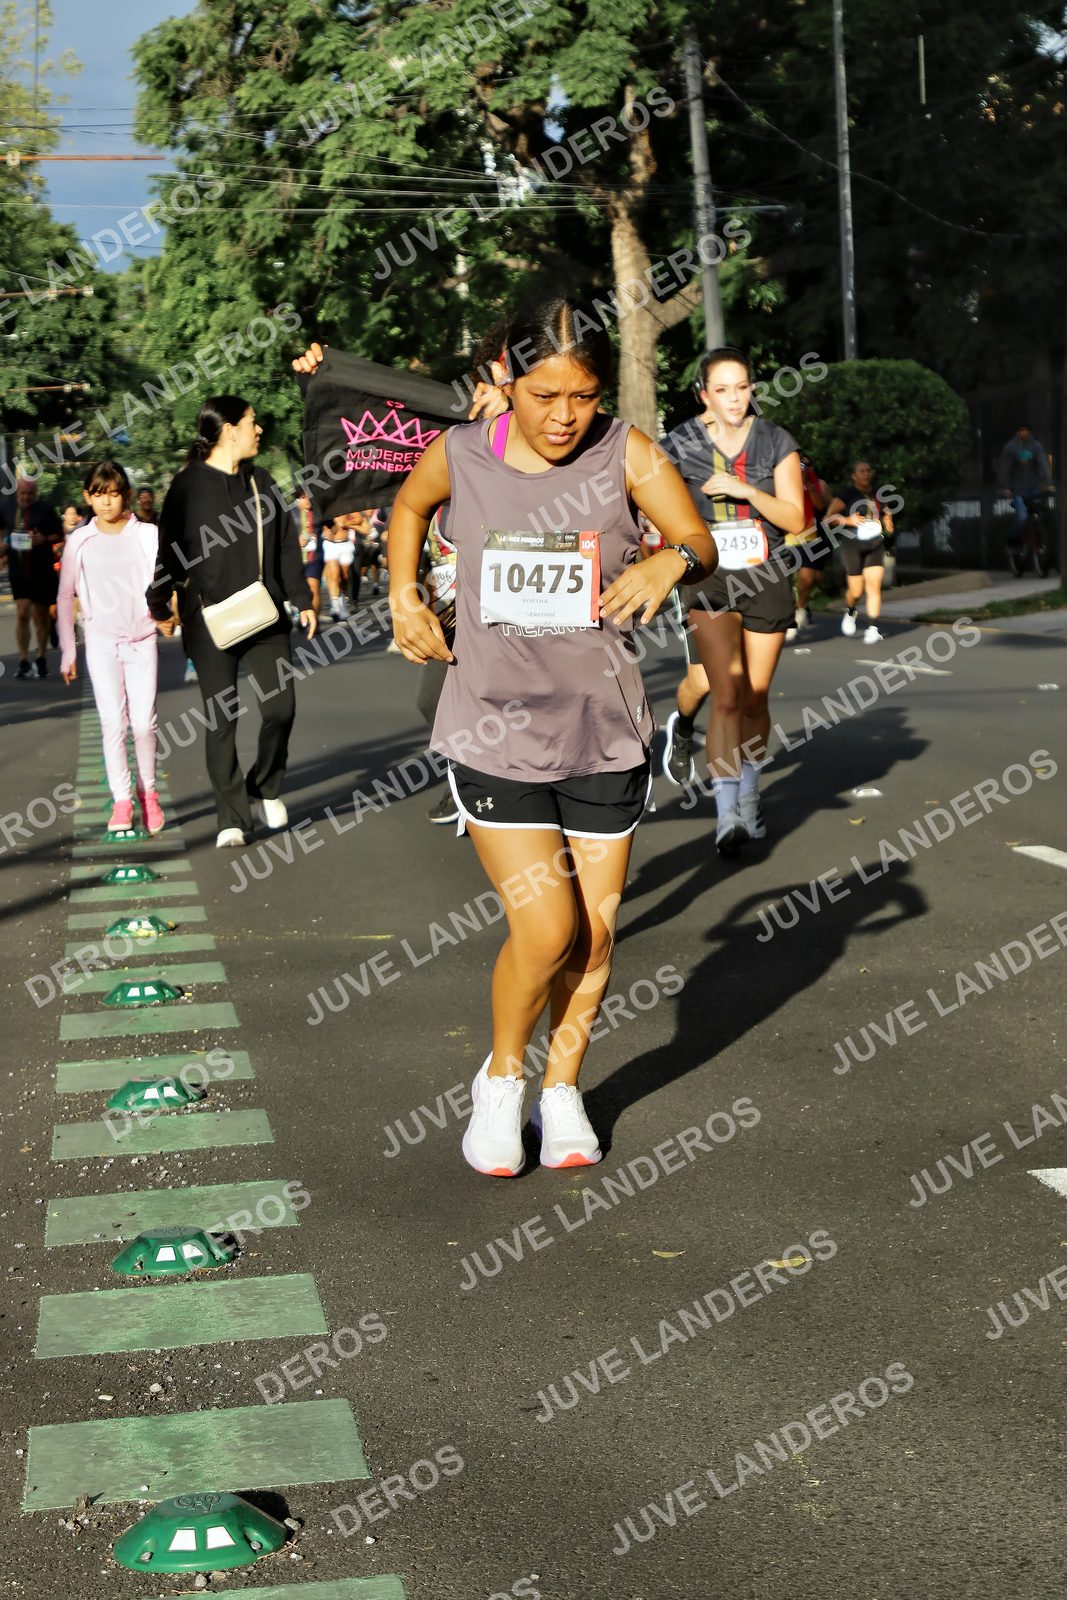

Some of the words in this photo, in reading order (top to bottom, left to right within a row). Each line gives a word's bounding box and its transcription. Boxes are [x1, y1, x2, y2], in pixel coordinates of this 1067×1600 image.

[346, 448, 424, 463] MUJERES
[345, 460, 413, 473] RUNNERA
[719, 535, 759, 552] 2439
[488, 562, 584, 594] 10475
